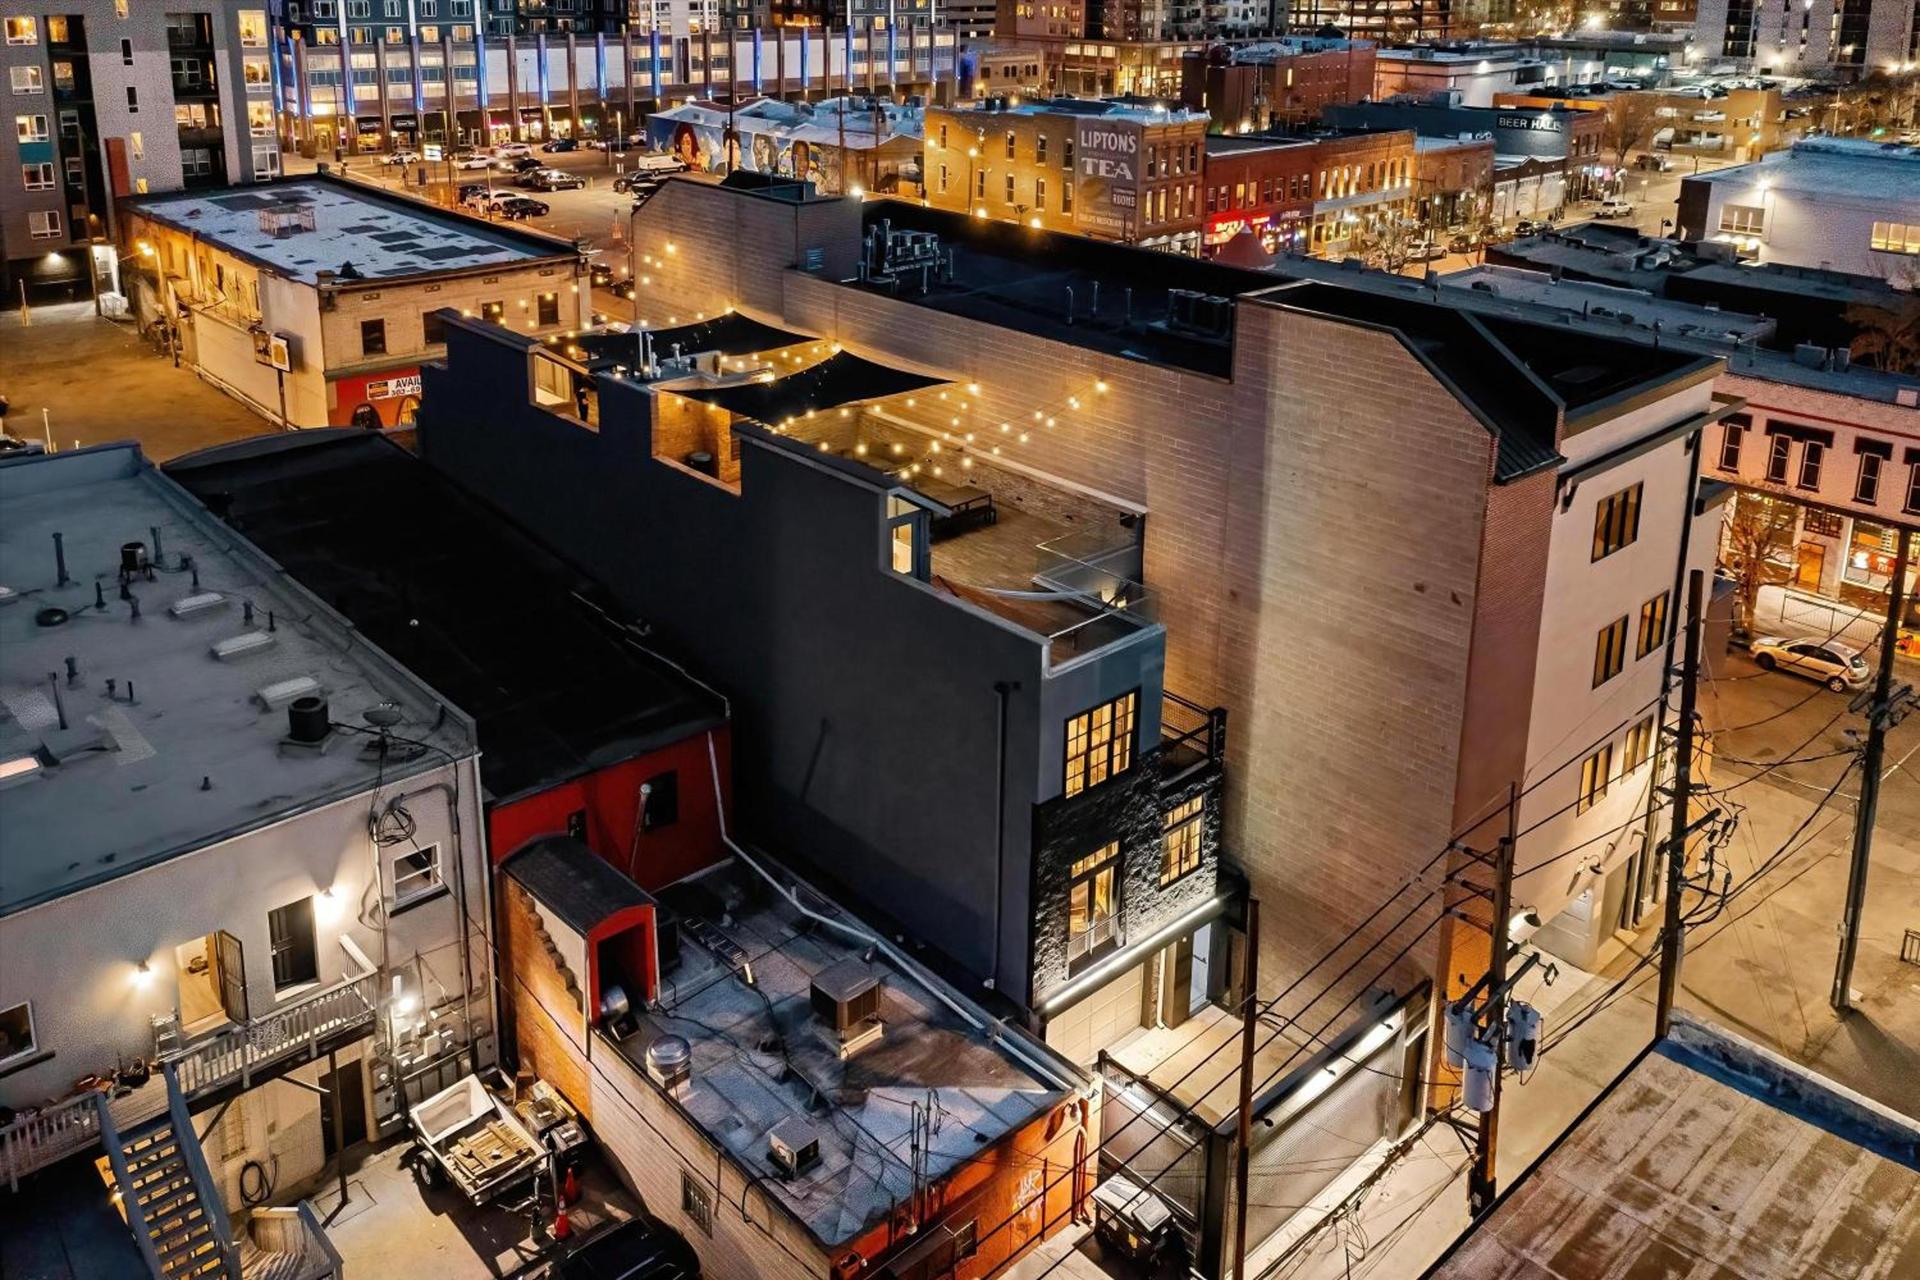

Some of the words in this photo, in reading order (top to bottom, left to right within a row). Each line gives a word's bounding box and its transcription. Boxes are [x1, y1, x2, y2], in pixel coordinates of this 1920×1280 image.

[1499, 117, 1527, 128] BEER
[1532, 118, 1561, 131] HALL
[1081, 130, 1136, 153] LIPTON'S
[1081, 157, 1133, 179] TEA
